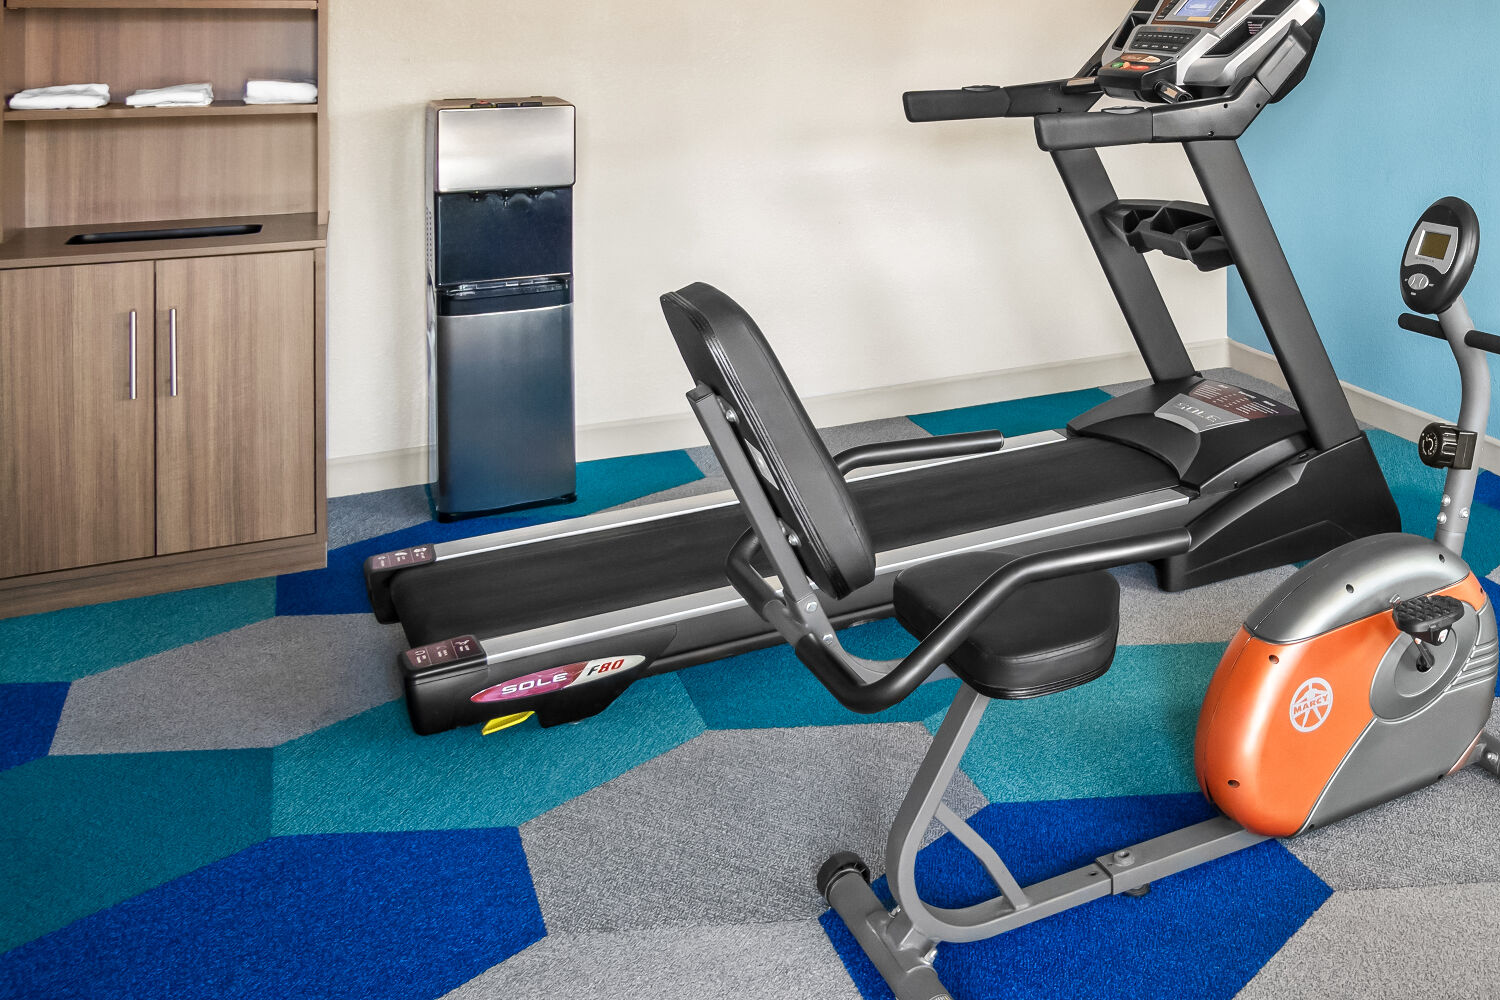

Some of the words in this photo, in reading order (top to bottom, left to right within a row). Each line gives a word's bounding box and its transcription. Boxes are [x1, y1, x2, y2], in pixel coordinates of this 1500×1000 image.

[1176, 402, 1219, 423] SOLE
[501, 672, 569, 695] SOLE
[587, 658, 625, 676] F80
[1293, 695, 1328, 715] MARCY
